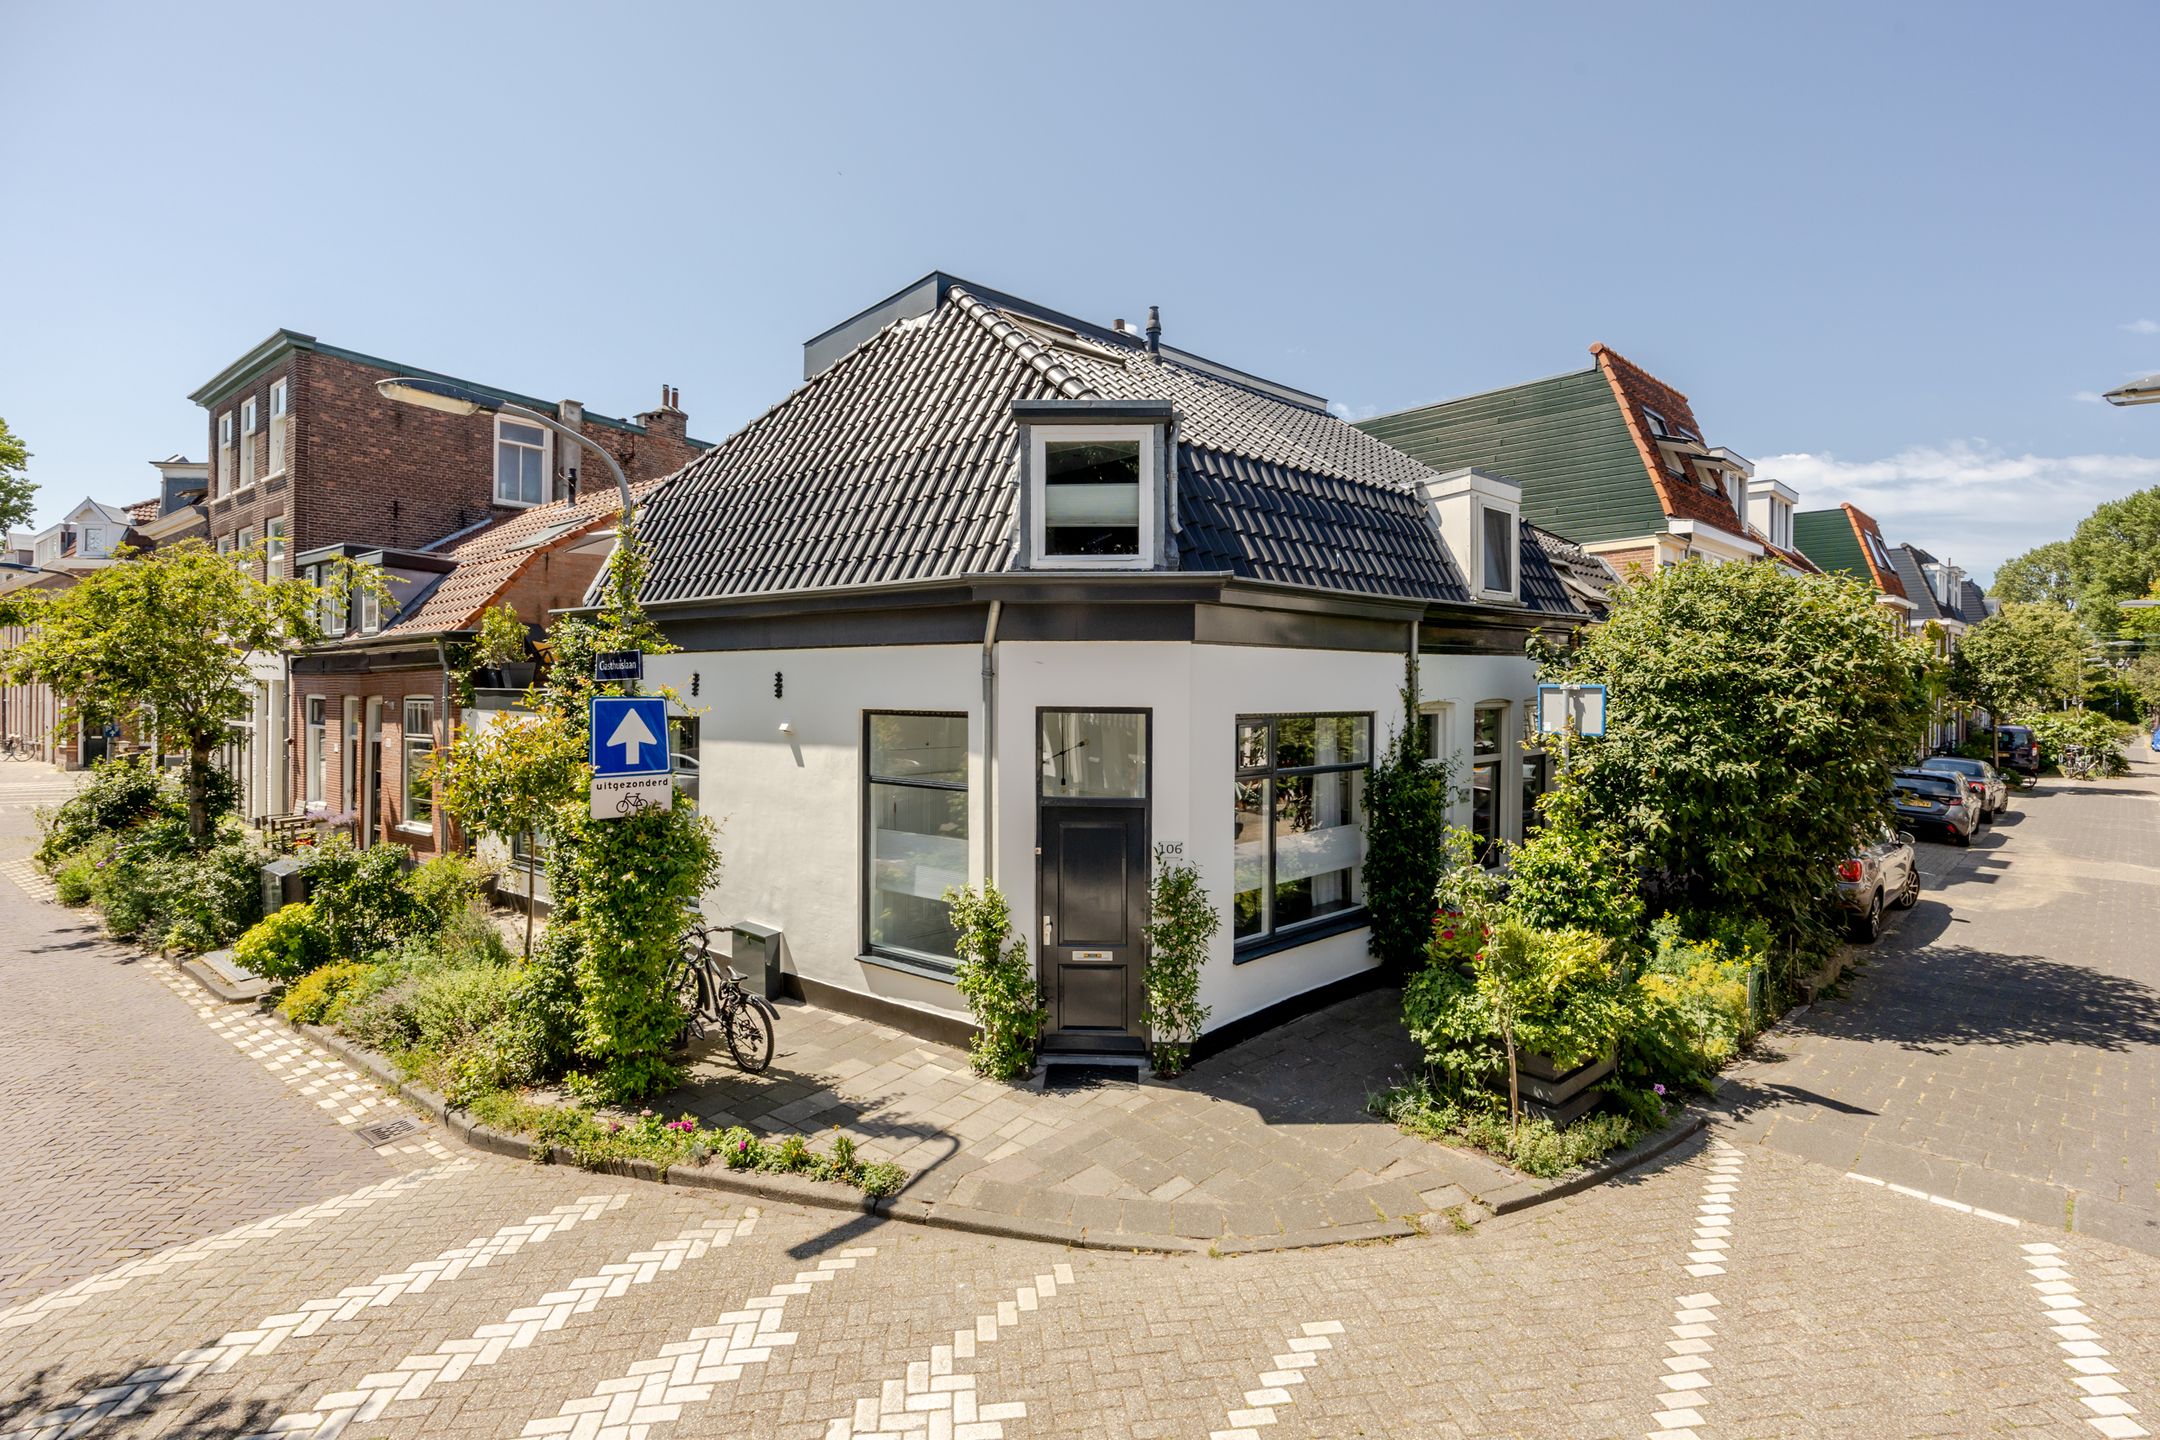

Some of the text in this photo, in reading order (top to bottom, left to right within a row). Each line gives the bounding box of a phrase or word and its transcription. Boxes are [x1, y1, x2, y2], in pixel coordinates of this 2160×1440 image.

[599, 659, 637, 671] Gasthuislaan
[596, 778, 668, 792] uitgezonderd
[1159, 844, 1182, 854] 106
